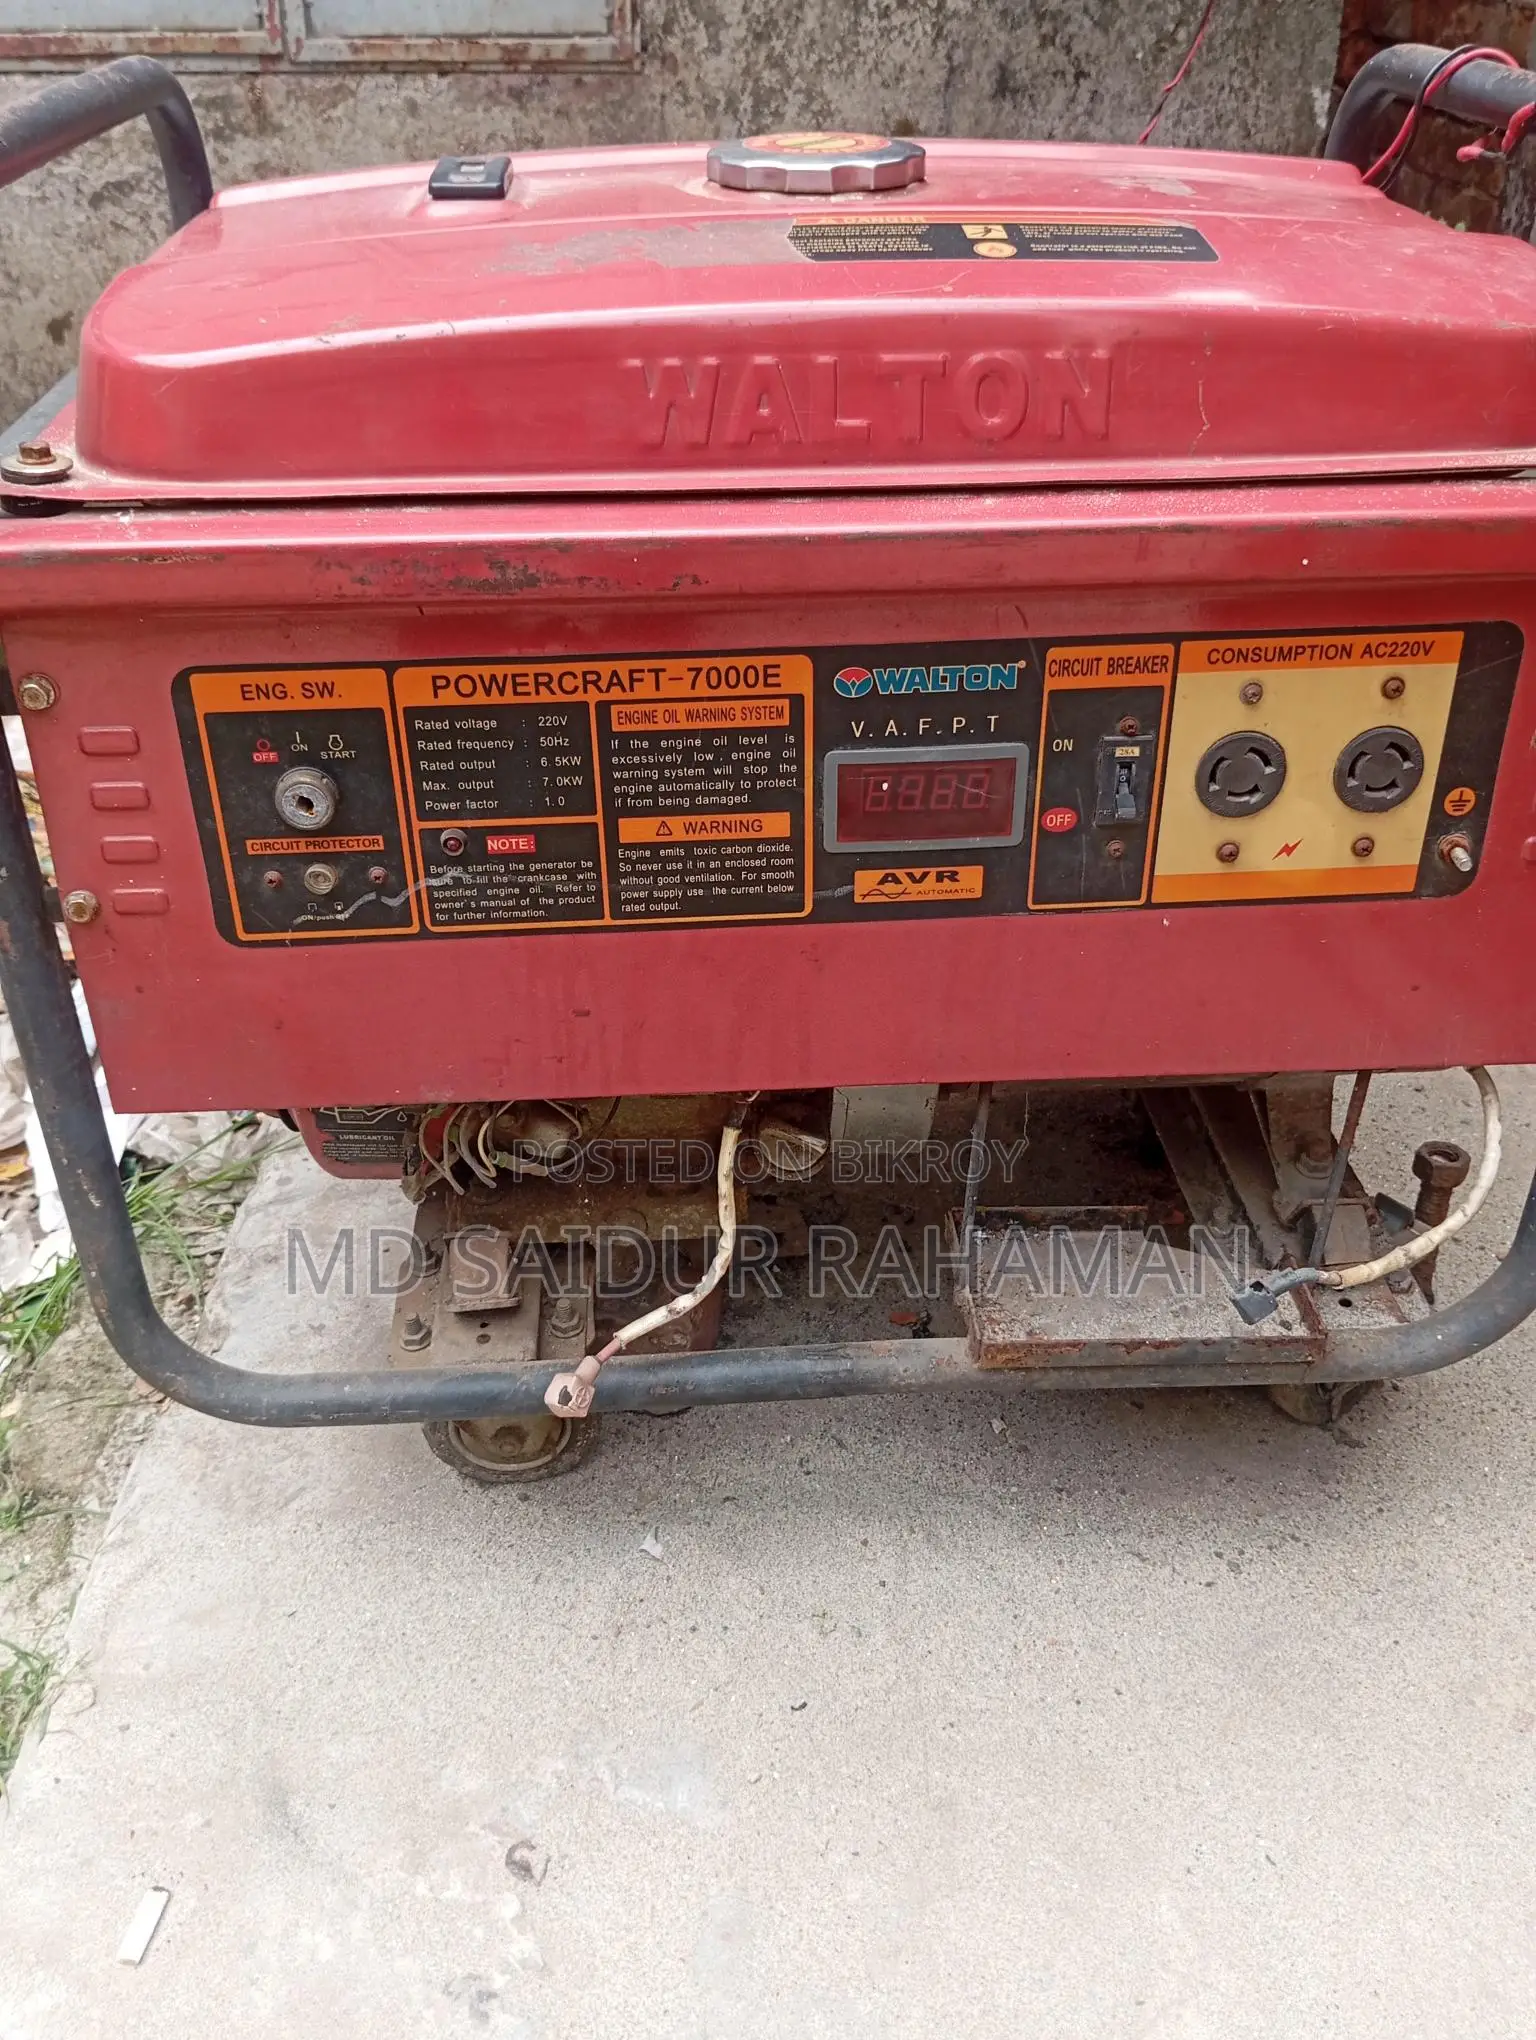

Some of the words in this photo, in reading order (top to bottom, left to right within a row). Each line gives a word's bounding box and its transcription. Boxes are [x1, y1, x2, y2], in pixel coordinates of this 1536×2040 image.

[625, 348, 1116, 450] WALTON
[1207, 644, 1353, 665] CONSUMPTION
[1360, 640, 1435, 659] AC220V
[1048, 656, 1103, 677] CIRCUIT
[1107, 655, 1169, 674] BREAKER
[431, 663, 782, 699] POWERCRAFT-7000E
[240, 683, 294, 701] ENG.
[301, 682, 342, 699] SW.
[617, 710, 658, 725] ENGINE
[663, 709, 680, 723] OIL
[685, 707, 736, 722] WARNING
[740, 705, 784, 721] SYSTEM
[415, 720, 449, 730] Rated
[455, 718, 497, 730] voltage
[538, 716, 568, 726] 220V
[417, 740, 452, 751] Rated
[457, 739, 514, 750] frequency
[540, 737, 569, 747] 50Hz
[611, 739, 618, 749] If
[630, 739, 649, 748] the
[661, 738, 701, 749] engine
[713, 736, 727, 746] oil
[739, 734, 768, 744] level
[785, 734, 795, 743] is
[1052, 739, 1073, 752] ON
[253, 753, 278, 762] OFF
[321, 751, 356, 760] START
[612, 753, 682, 764] excessively
[732, 749, 771, 761] engine
[783, 748, 796, 758] oil
[420, 760, 454, 771] Rated
[460, 759, 496, 771] output
[612, 769, 658, 779] warning
[664, 767, 705, 779] system
[713, 765, 732, 775] will
[744, 764, 768, 775] stop
[779, 763, 797, 773] the
[422, 781, 450, 791] Max.
[458, 779, 494, 791] output
[614, 783, 652, 795] engine
[658, 780, 735, 792] automatically
[741, 780, 751, 788] to
[757, 778, 797, 789] protect
[425, 800, 460, 811] Power
[466, 799, 499, 809] factor
[615, 798, 622, 807] if
[627, 797, 652, 807] from
[659, 795, 690, 807] being
[696, 794, 752, 805] damaged.
[683, 819, 763, 835] WARNING
[1046, 814, 1072, 827] OFF
[251, 841, 301, 852] CIRCUIT
[305, 838, 381, 850] PROTECTOR
[488, 838, 535, 850] NOTE:
[618, 849, 651, 859] Engine
[660, 847, 685, 856] emits
[694, 846, 717, 855] toxic
[721, 844, 752, 854] carbon
[757, 843, 793, 852] dioxide.
[430, 865, 463, 874] Before
[468, 863, 504, 873] starting
[509, 862, 524, 870] the
[529, 861, 576, 871] generator
[581, 860, 593, 868] be
[619, 862, 632, 872] So
[636, 861, 661, 871] never
[666, 861, 683, 869] use
[687, 860, 693, 869] it
[697, 859, 705, 868] in
[709, 859, 720, 868] an
[725, 858, 766, 867] enclosed
[771, 857, 794, 866] room
[493, 875, 508, 883] the
[518, 873, 567, 882] crankcase
[577, 871, 597, 880] with
[619, 875, 654, 886] without
[657, 874, 680, 886] good
[685, 872, 734, 882] ventilation.
[742, 871, 757, 880] For
[761, 870, 795, 879] smooth
[876, 870, 960, 886] AVR
[433, 887, 477, 898] specified
[487, 886, 520, 897] engine
[529, 885, 543, 894] oil.
[556, 884, 582, 893] Refer
[586, 883, 596, 891] to
[621, 889, 649, 900] power
[653, 887, 683, 899] supply
[687, 887, 704, 896] use
[712, 886, 726, 895] the
[731, 884, 763, 894] current
[767, 883, 794, 892] below
[916, 887, 976, 896] AUTOMATIC
[480, 896, 516, 907] manual
[520, 896, 530, 906] of
[539, 896, 554, 904] the
[559, 895, 596, 905] product
[621, 901, 646, 912] rated
[649, 900, 682, 912] output.
[435, 911, 450, 921] for
[453, 910, 486, 920] further
[490, 909, 548, 918] information.
